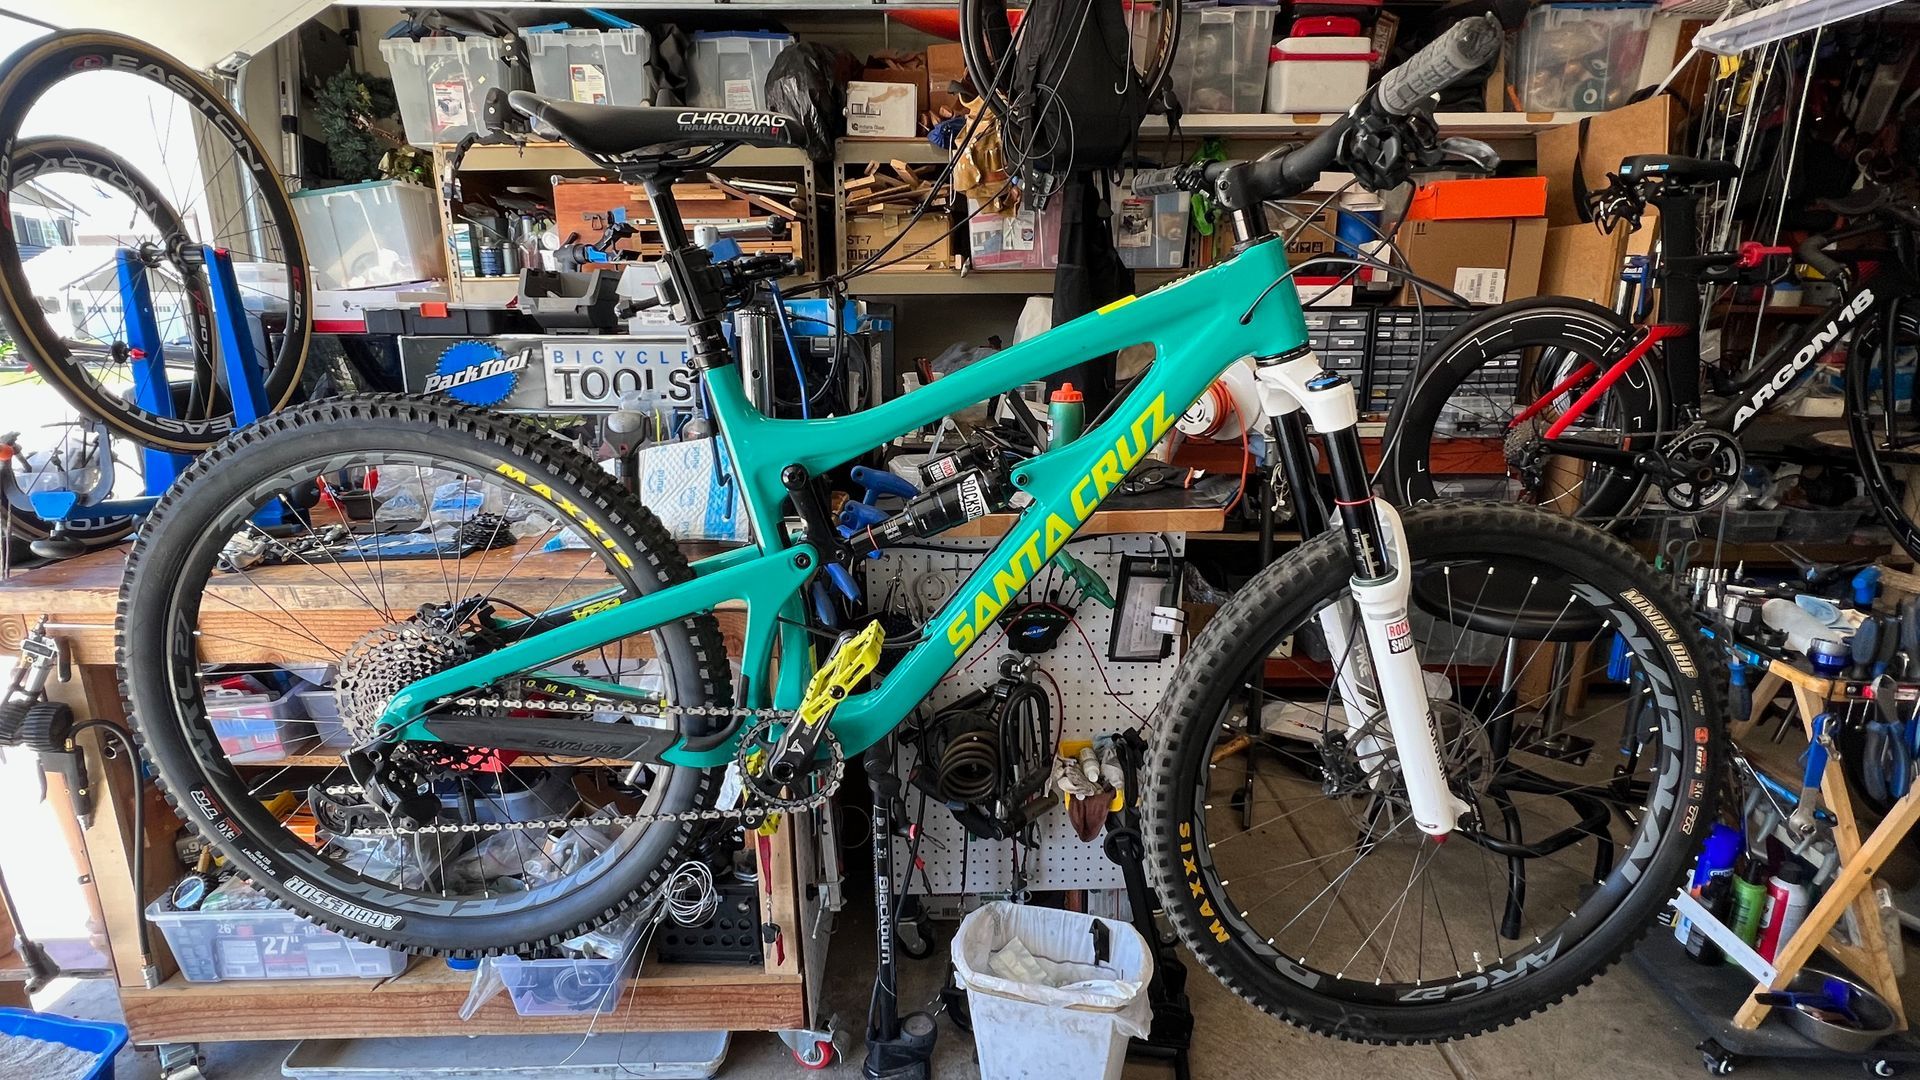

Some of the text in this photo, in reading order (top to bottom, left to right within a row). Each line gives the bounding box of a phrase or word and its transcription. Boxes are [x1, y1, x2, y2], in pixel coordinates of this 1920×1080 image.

[111, 53, 265, 172] EASTON
[676, 111, 786, 127] CHROMAG
[679, 123, 749, 133] TRAILMASTER
[10, 156, 158, 215] EASTON
[553, 350, 689, 365] BICYCLE
[1732, 288, 1875, 433] ARGON 18
[64, 355, 233, 435] EASTON
[553, 367, 693, 401] TOOLS
[495, 462, 635, 570] MAXXIS
[962, 479, 984, 520] ROCKSH
[946, 390, 1176, 658] SANTA CRUZ
[1388, 621, 1410, 637] ROCK
[1620, 588, 1698, 678] MINION DHF
[1354, 642, 1371, 678] PIKE
[536, 738, 583, 751] SANTA
[215, 820, 237, 842] EXO
[282, 874, 403, 931] AGGRESSOR
[1178, 821, 1231, 944] MAXXIS
[217, 923, 236, 935] 26"
[878, 875, 892, 965] Blackburn
[262, 935, 300, 955] 27"
